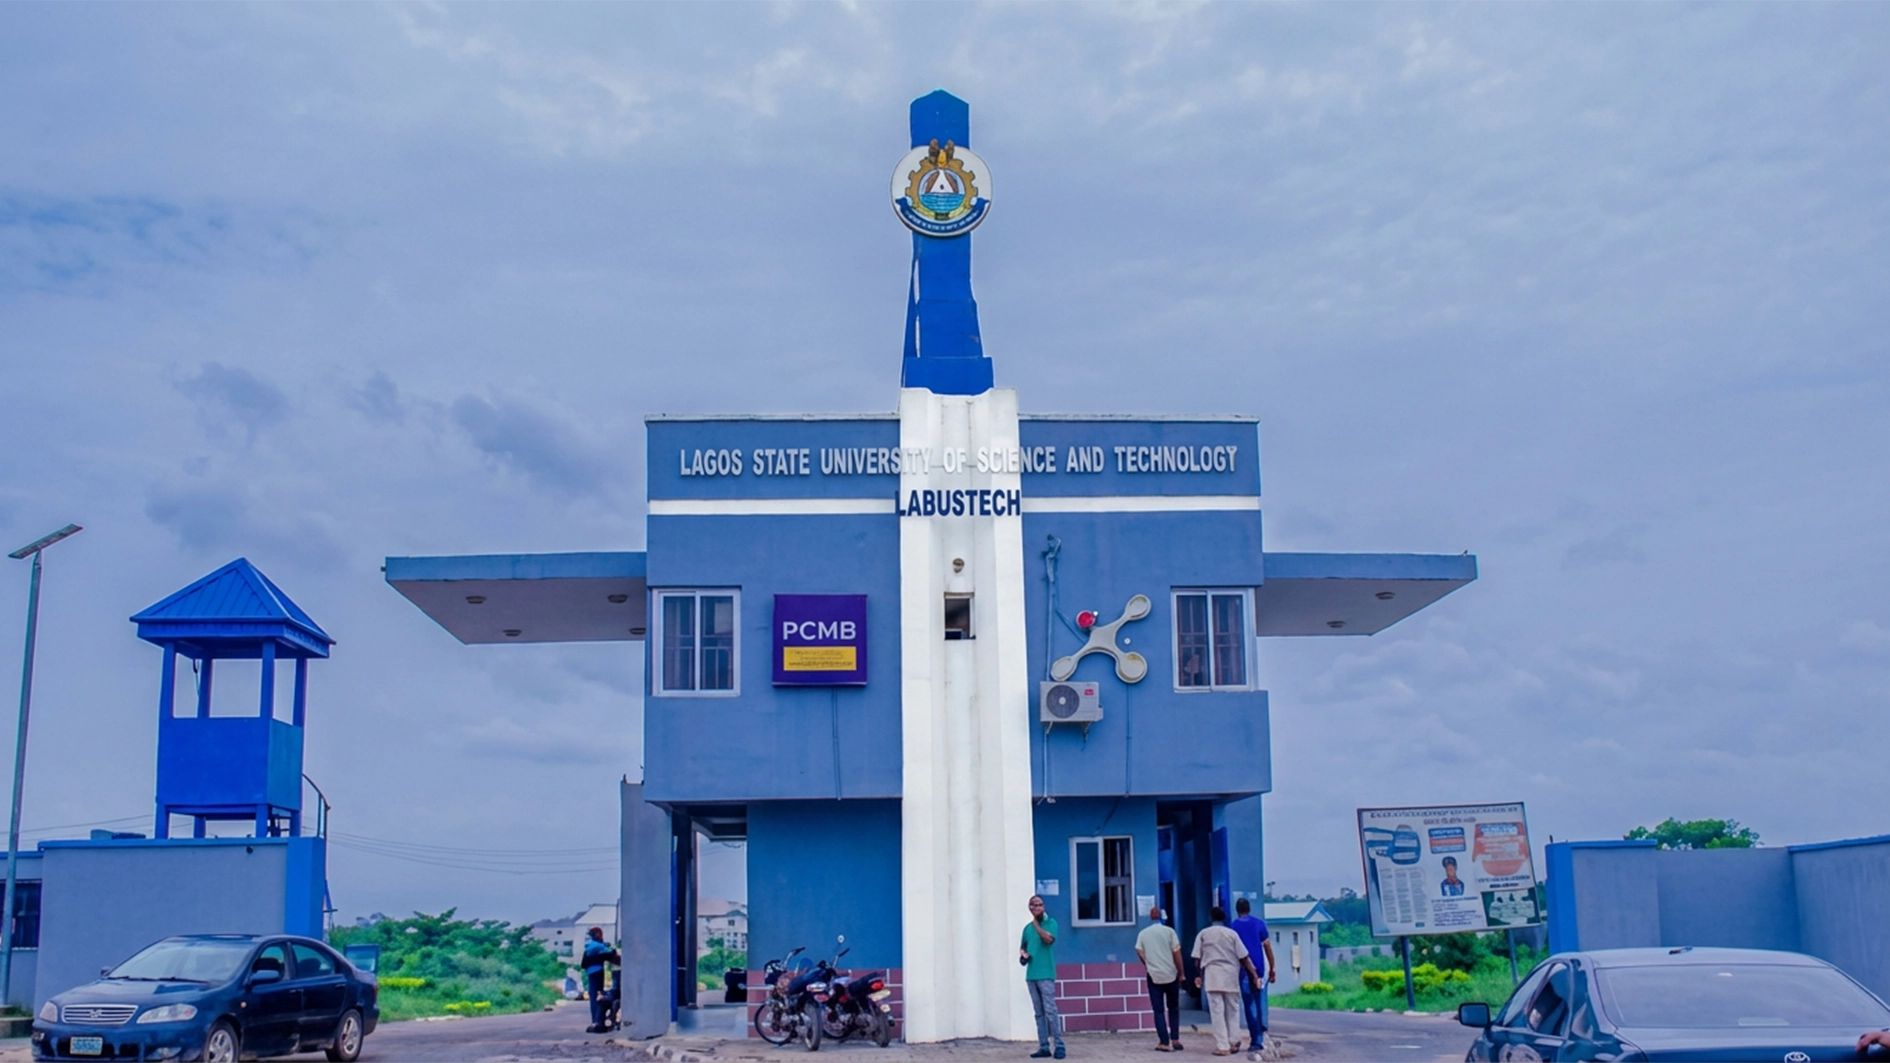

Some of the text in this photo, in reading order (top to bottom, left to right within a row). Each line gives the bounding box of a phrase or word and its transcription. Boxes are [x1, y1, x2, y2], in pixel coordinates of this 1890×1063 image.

[680, 445, 1238, 476] LAGOS STATE UNIVERSITY OF SCIENCE AND TECHNOLOGY
[894, 489, 1021, 517] LABUSTECH
[782, 620, 857, 641] PCMB
